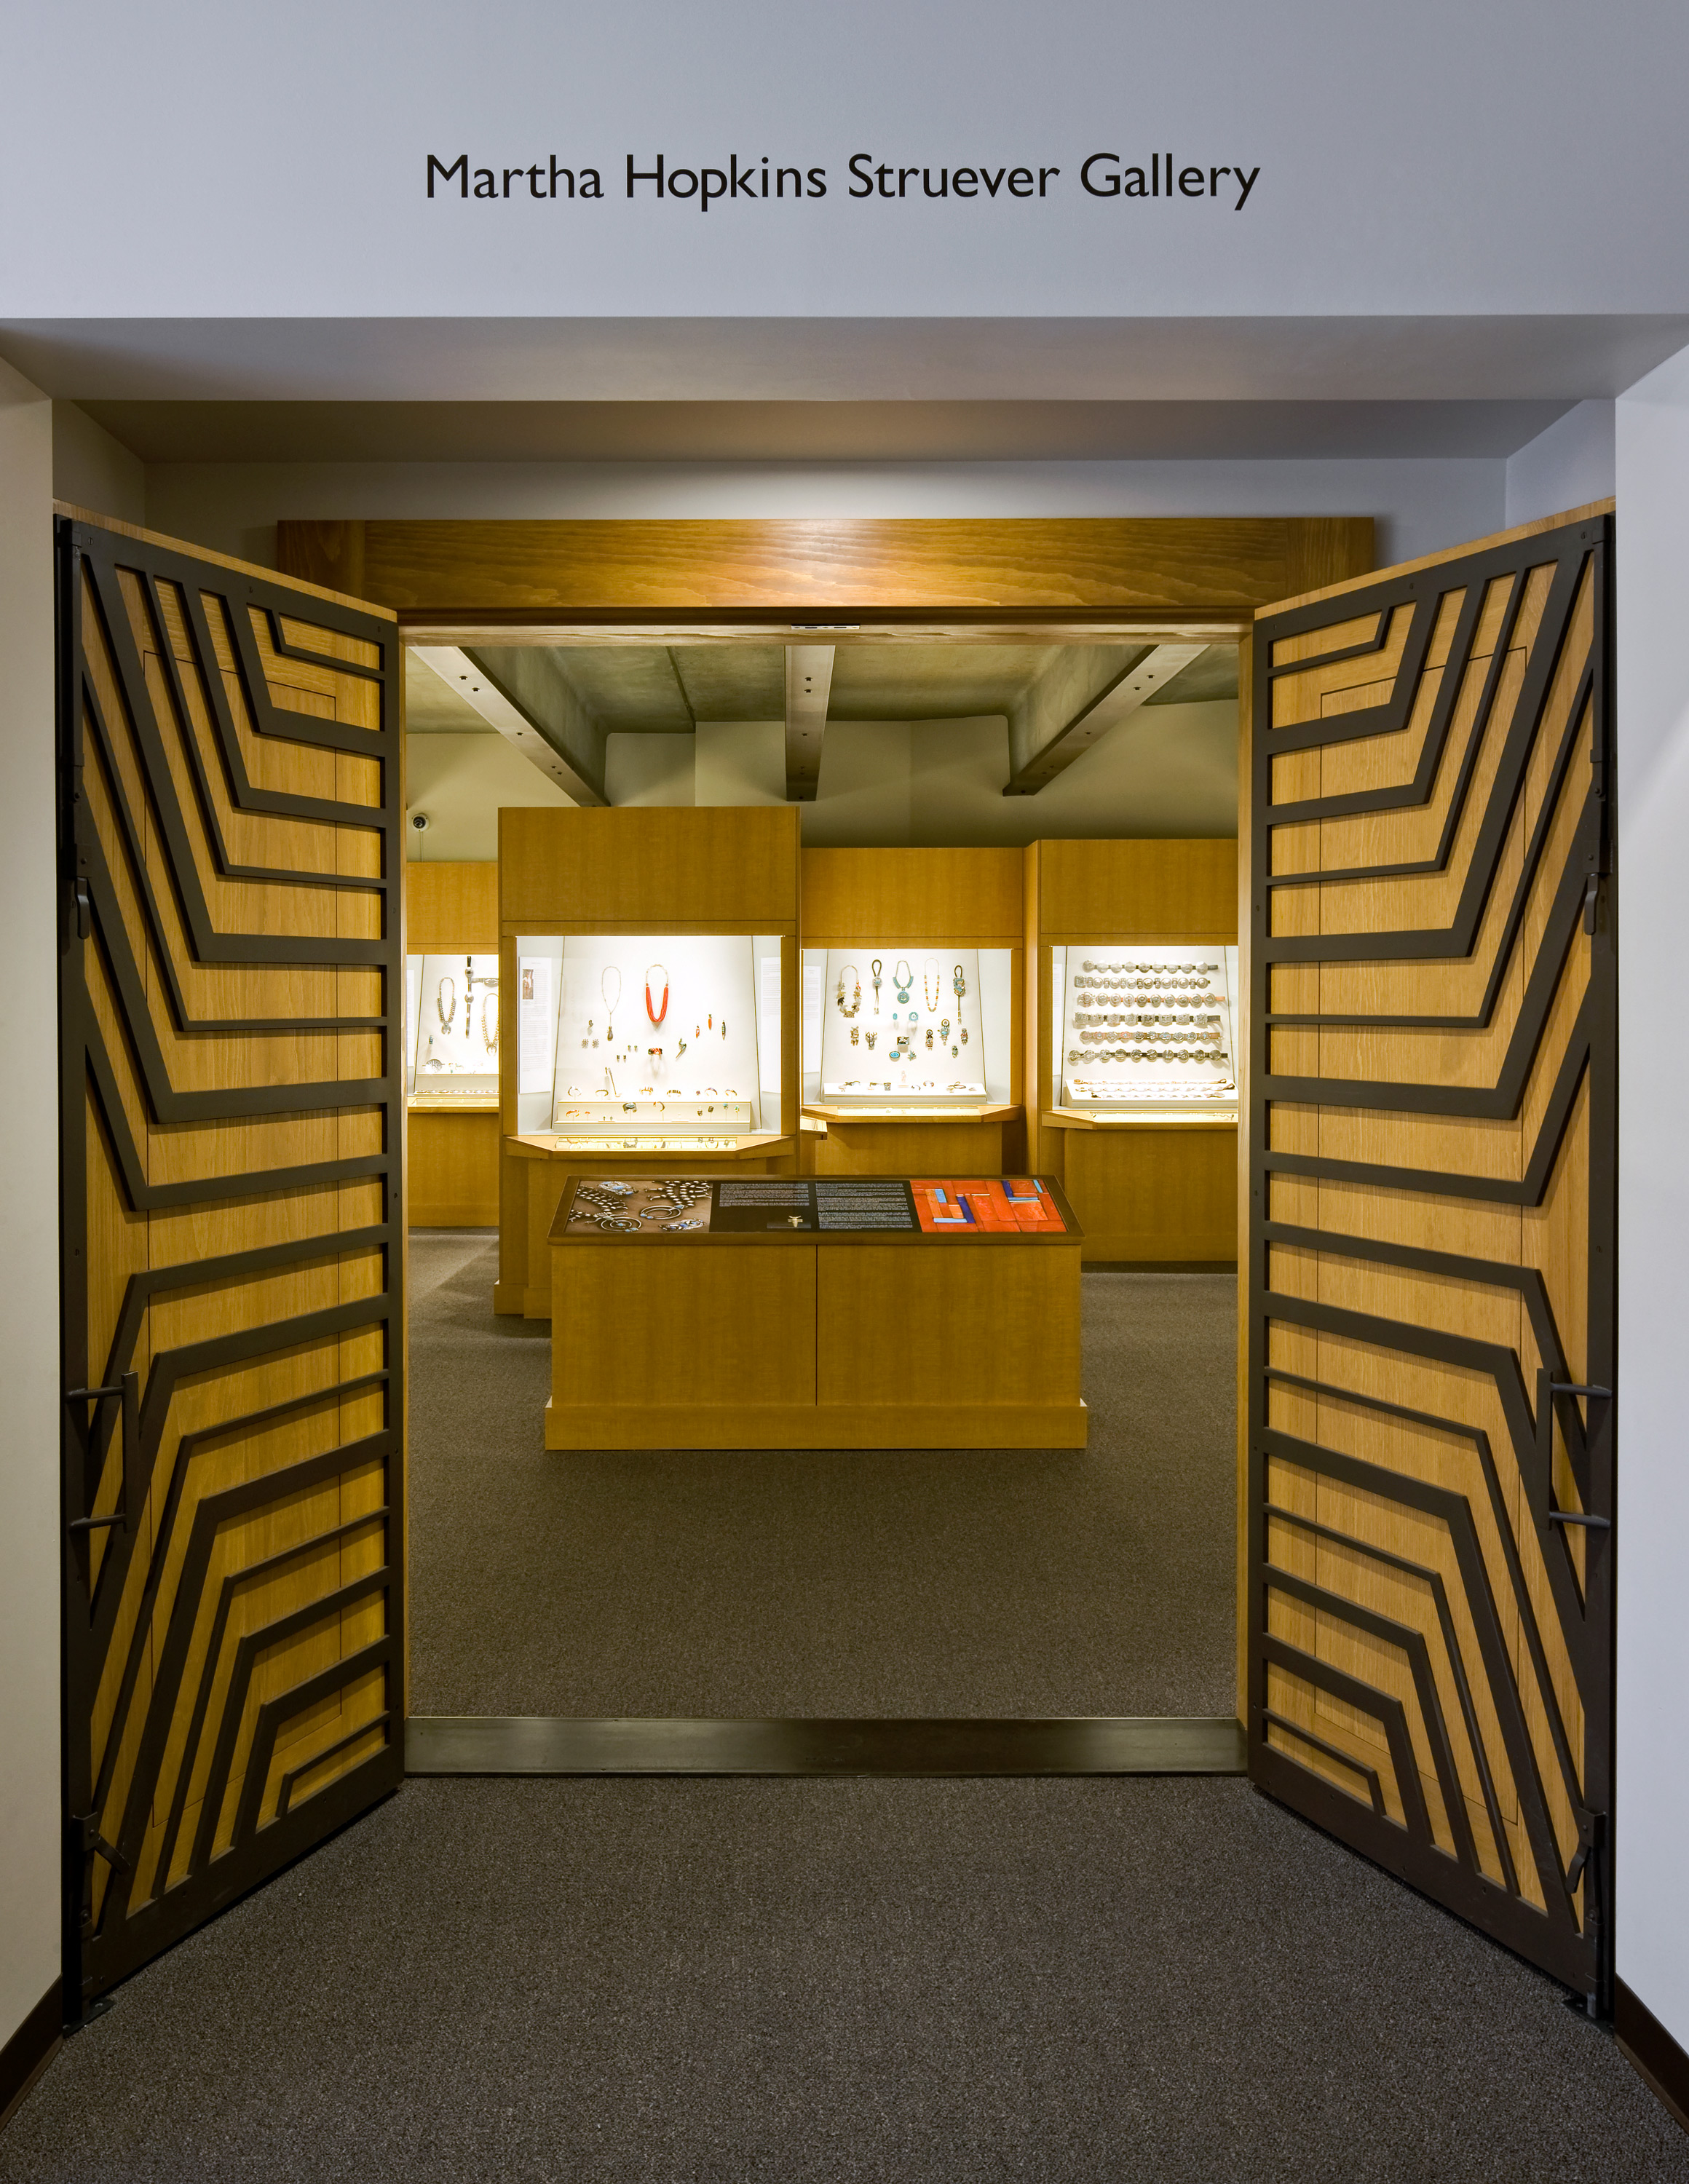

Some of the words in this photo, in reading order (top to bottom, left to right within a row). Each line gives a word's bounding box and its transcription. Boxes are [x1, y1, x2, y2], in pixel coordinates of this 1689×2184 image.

[427, 155, 604, 199] Martha
[627, 154, 827, 213] Hopkins
[848, 153, 1061, 198] Struever
[1081, 152, 1261, 211] Gallery
